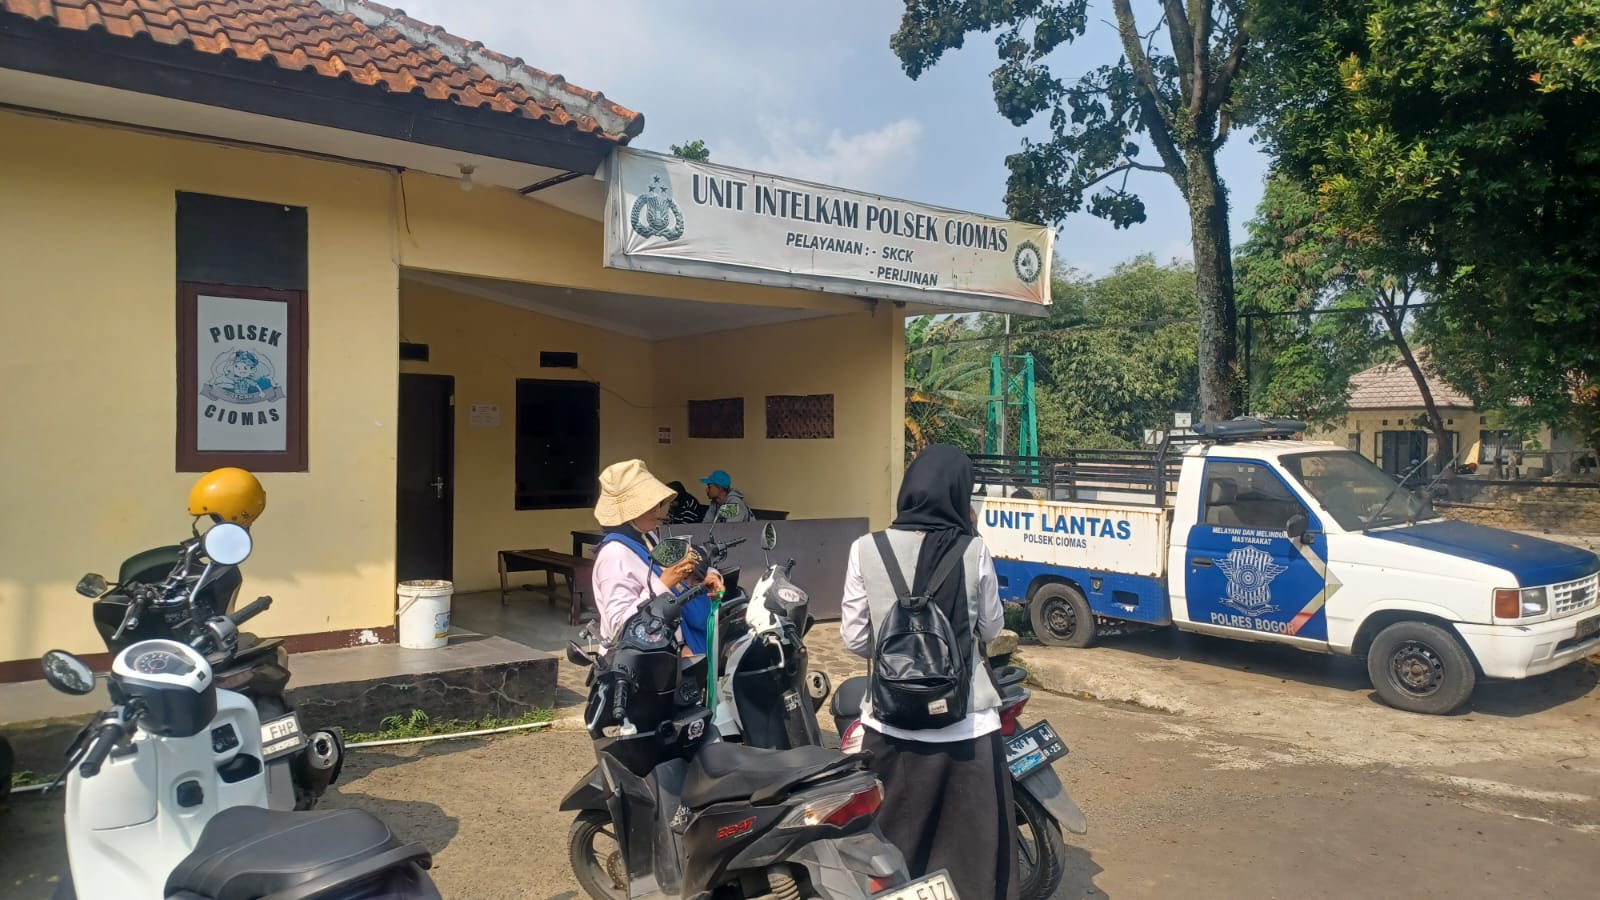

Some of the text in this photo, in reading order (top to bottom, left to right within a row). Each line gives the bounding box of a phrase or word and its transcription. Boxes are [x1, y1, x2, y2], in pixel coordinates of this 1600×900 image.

[692, 173, 1009, 252] UNIT INTELKAM POLSEK CIOMAS
[785, 232, 863, 256] PELAYANAN
[881, 247, 914, 263] SKCK
[877, 266, 938, 287] PERIJINAN
[208, 324, 283, 347] POLSEK
[203, 404, 280, 426] CIOMAS
[985, 509, 1131, 540] UNIT LANTAS
[1023, 533, 1087, 549] POLSEK CIOMAS
[1231, 535, 1273, 545] MASYARAKAT
[1210, 612, 1295, 635] POLRES BOGOR
[269, 720, 294, 739] FHP
